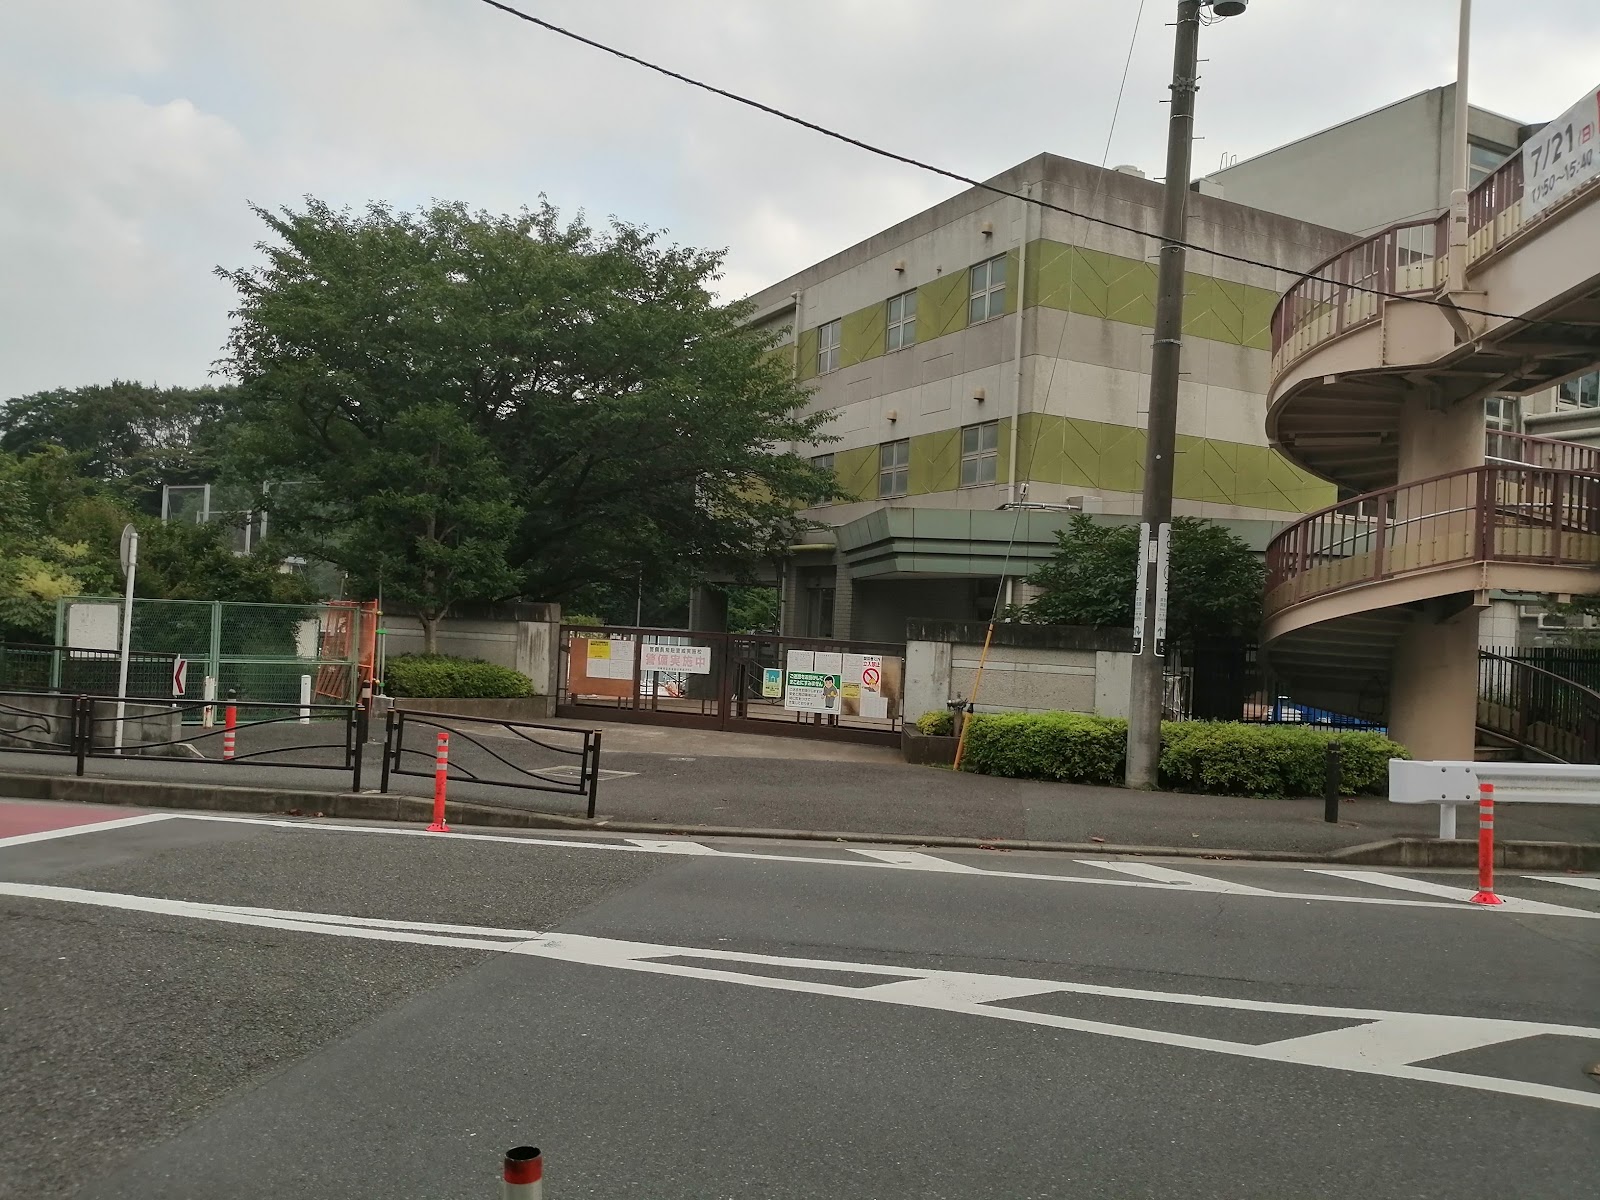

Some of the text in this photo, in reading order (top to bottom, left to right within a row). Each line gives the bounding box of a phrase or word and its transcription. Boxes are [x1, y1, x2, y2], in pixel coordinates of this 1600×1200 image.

[646, 653, 705, 667] 警備実施中
